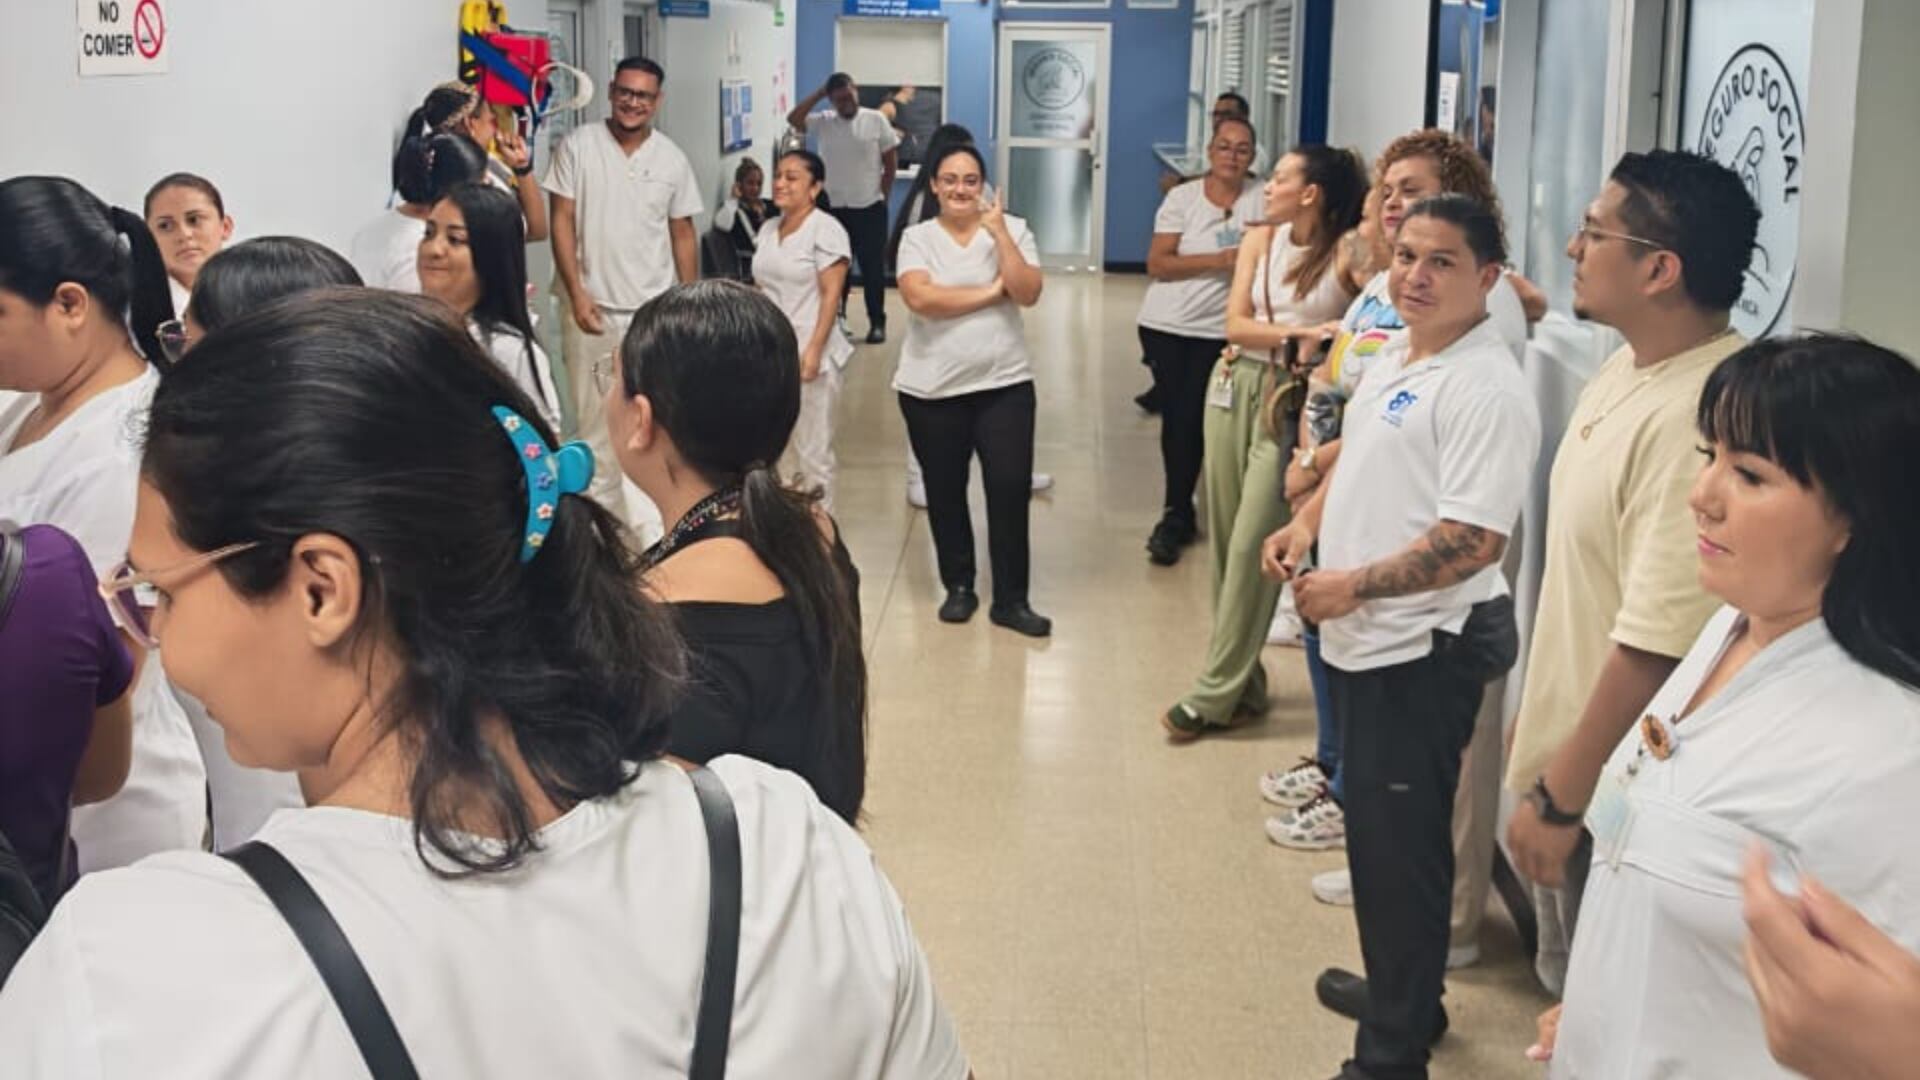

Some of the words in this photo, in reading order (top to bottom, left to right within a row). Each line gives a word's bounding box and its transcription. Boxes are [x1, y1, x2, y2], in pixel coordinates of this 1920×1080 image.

[98, 1, 119, 22] NO
[83, 33, 135, 56] COMER
[1705, 64, 1755, 159] EGURO
[1757, 67, 1799, 203] SOCIAL
